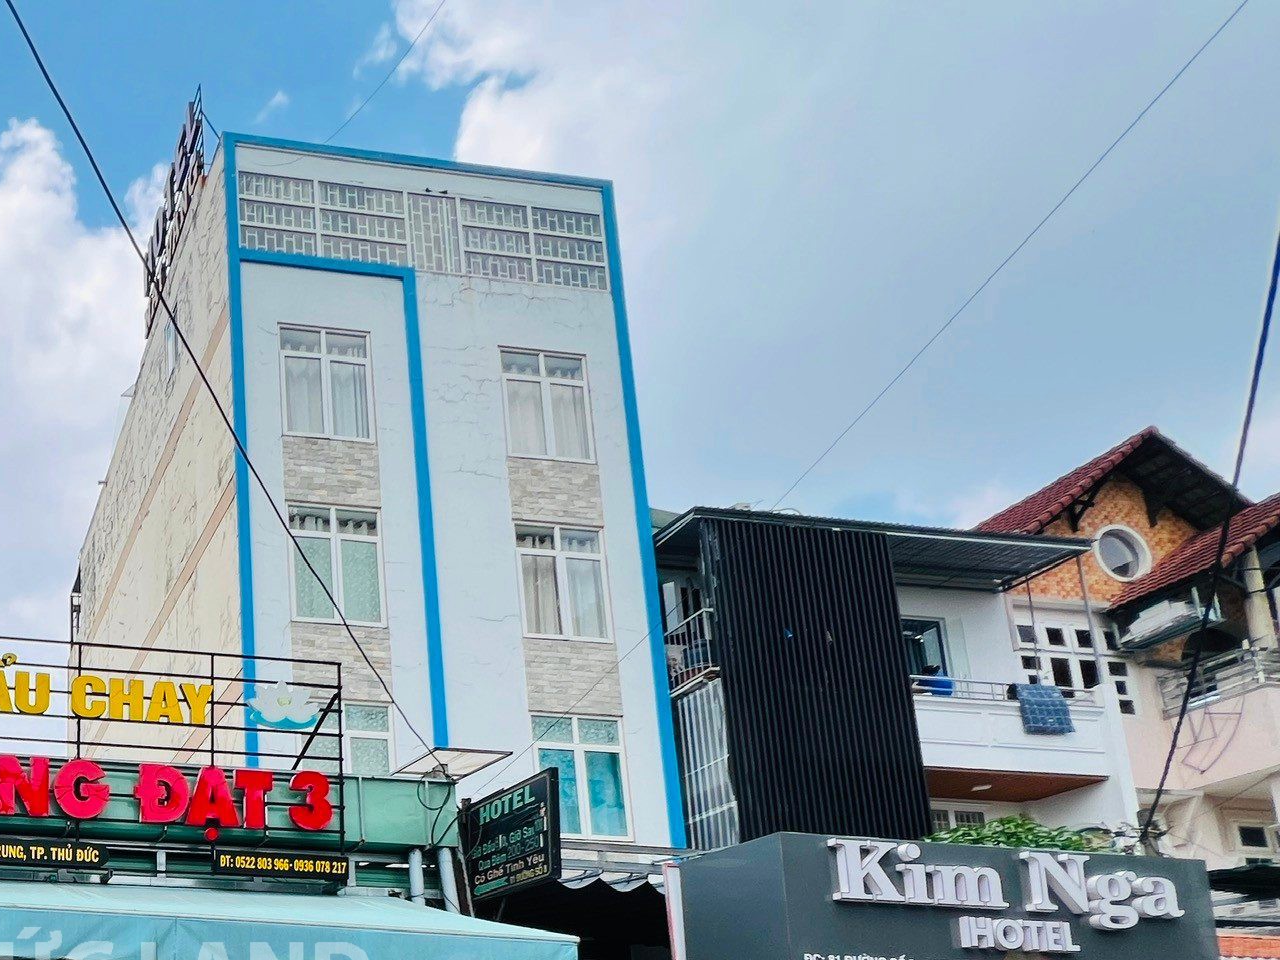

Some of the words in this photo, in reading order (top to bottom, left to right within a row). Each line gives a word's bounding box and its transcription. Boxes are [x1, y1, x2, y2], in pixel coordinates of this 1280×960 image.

[71, 675, 213, 726] CHAY
[133, 763, 275, 842] ĐẠT
[289, 770, 333, 832] 3
[479, 785, 535, 825] HOTEL
[30, 846, 47, 861] TP.
[51, 843, 73, 861] THỦ
[76, 845, 100, 863] ĐỨC
[220, 854, 234, 868] ĐT:
[235, 856, 255, 869] 0522
[257, 857, 272, 870] 803
[315, 860, 331, 873] 078
[332, 862, 347, 874] 217
[827, 837, 1010, 910] Kim
[1018, 851, 1185, 931] Nga
[958, 916, 1081, 953] HOTEL
